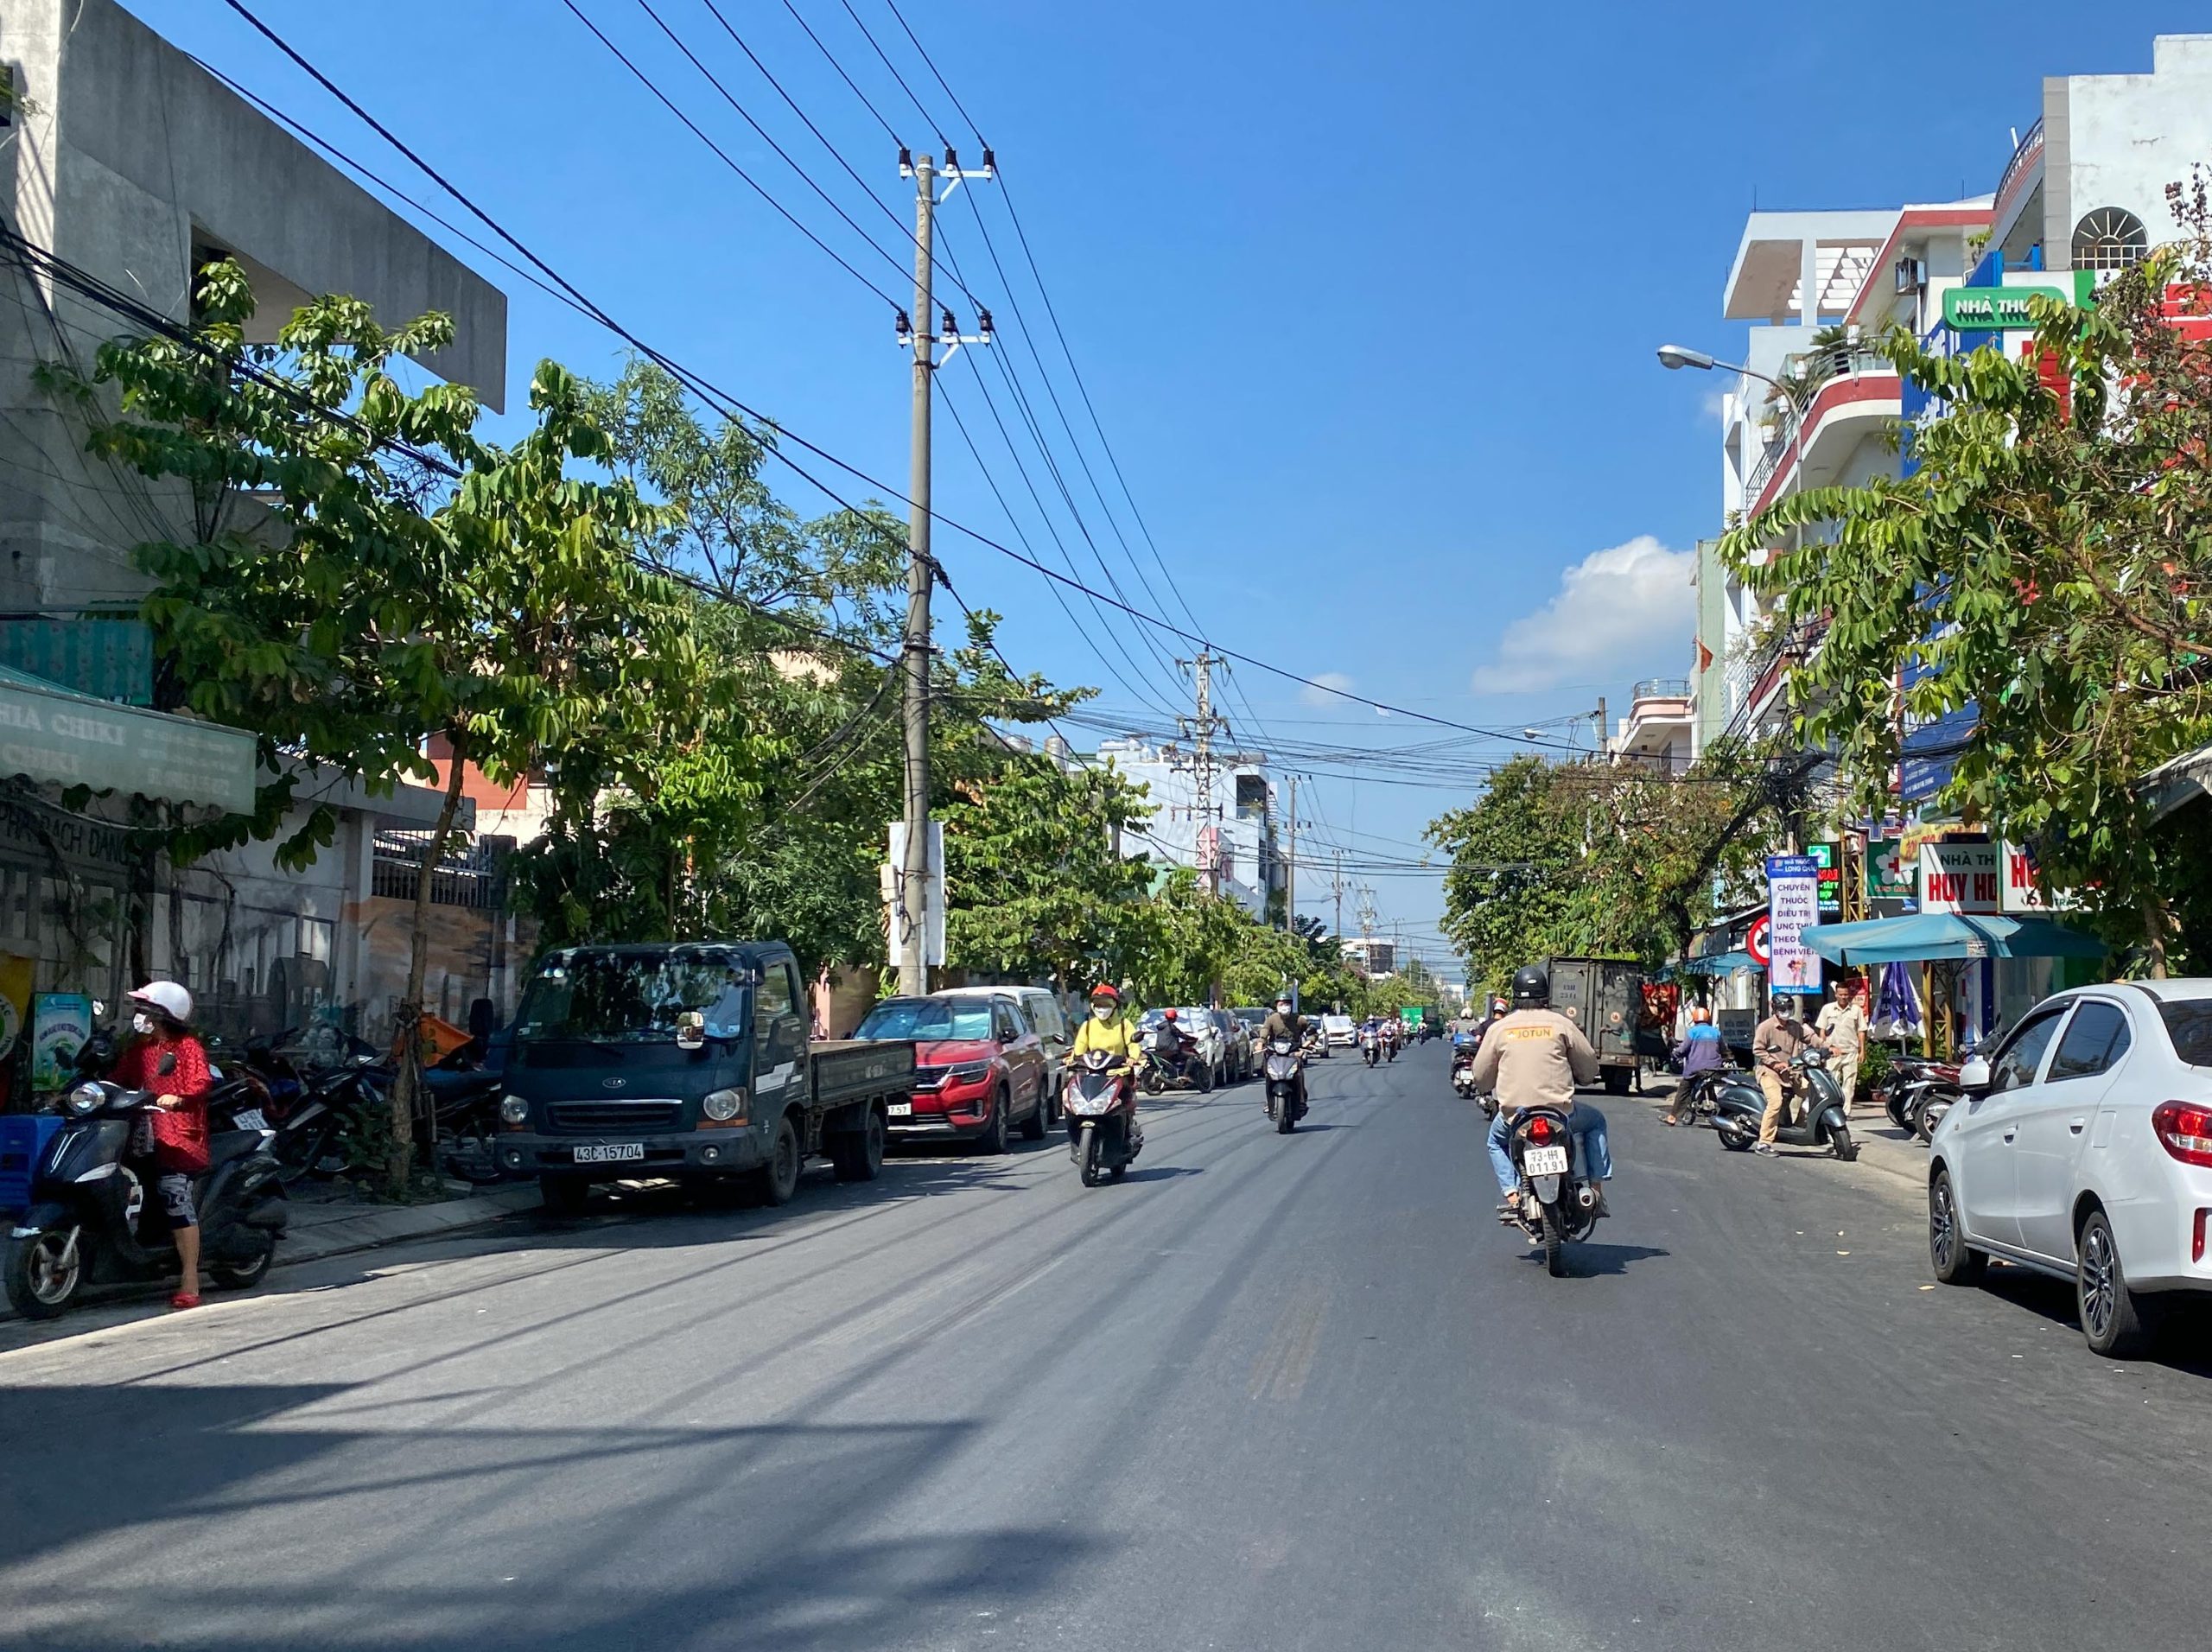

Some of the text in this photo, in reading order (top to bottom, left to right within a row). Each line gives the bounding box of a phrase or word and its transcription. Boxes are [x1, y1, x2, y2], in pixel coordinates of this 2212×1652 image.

[1955, 295, 2031, 315] NHÀ THU
[1941, 851, 1997, 866] NHÀ TH
[1777, 882, 1810, 891] CHUYÊN
[1929, 873, 1968, 902] HUY
[1773, 947, 1796, 957] BỆNH
[1517, 1028, 1552, 1039] JOTUN
